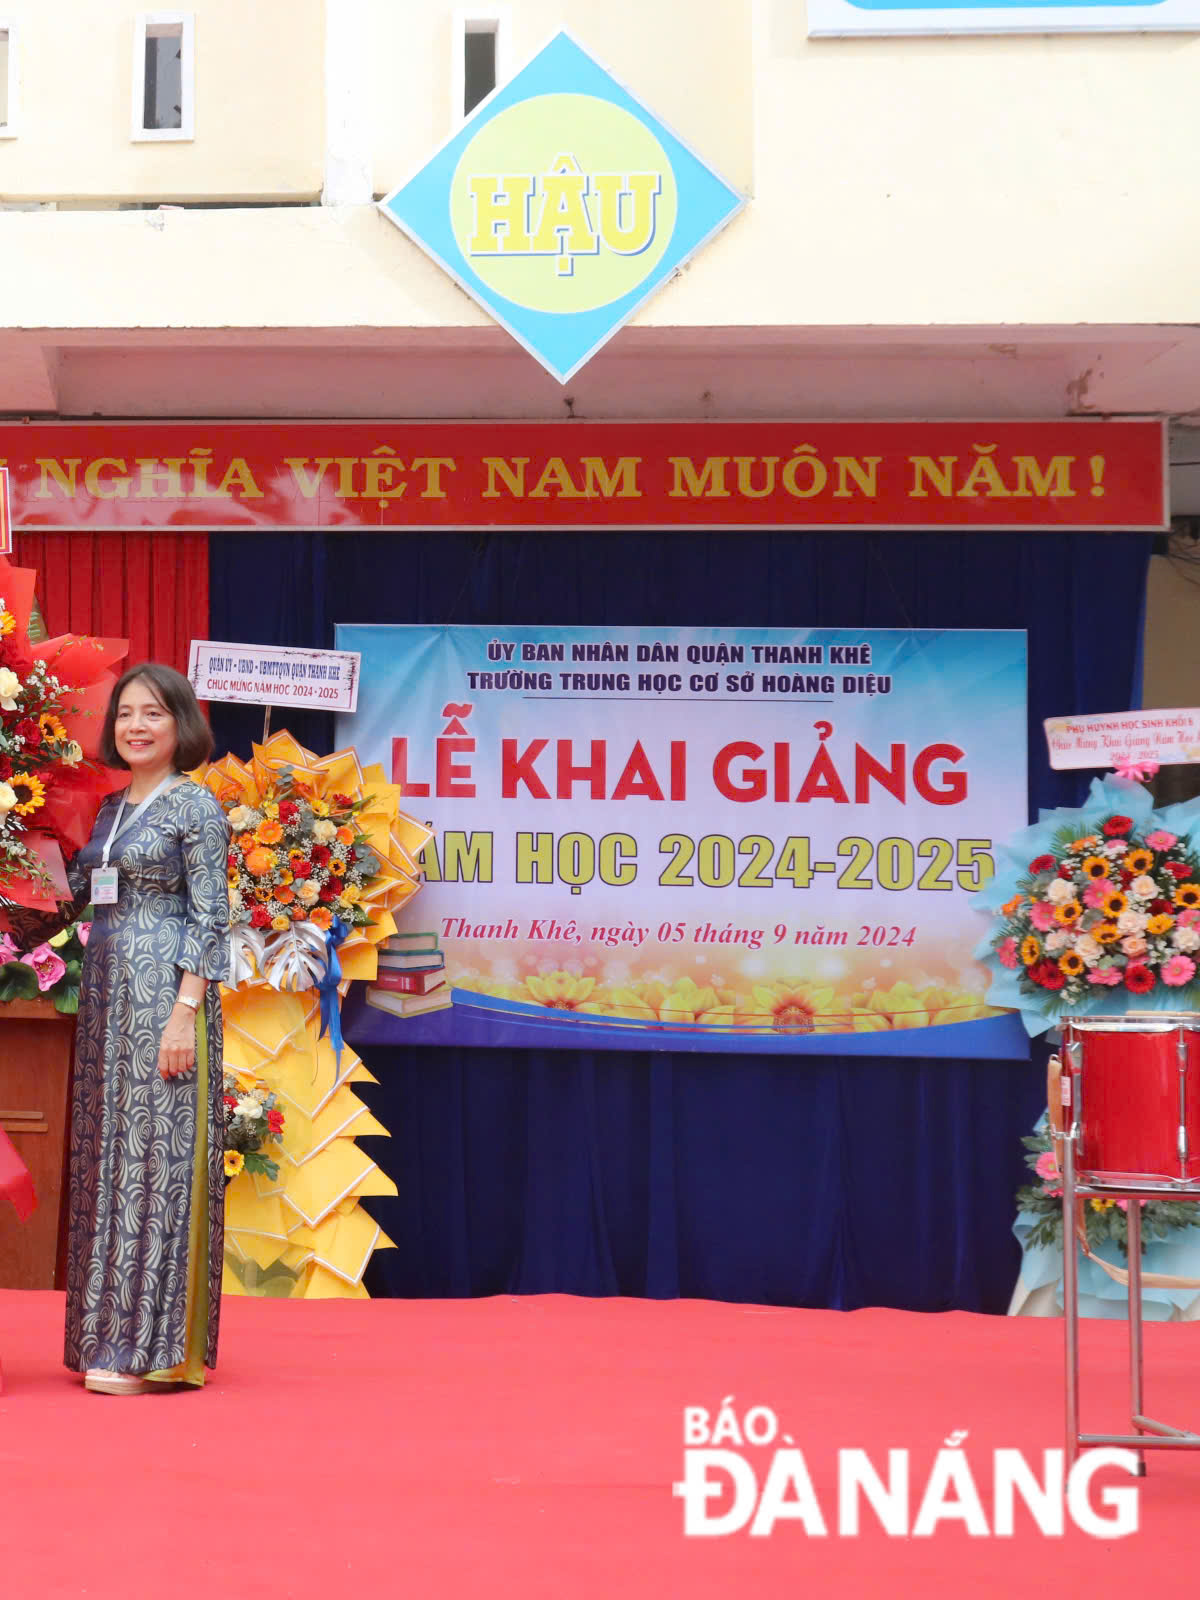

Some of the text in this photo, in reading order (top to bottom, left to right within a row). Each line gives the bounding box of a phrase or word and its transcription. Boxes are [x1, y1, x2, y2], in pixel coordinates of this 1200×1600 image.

[467, 152, 662, 277] HẬU
[34, 447, 265, 499] NGHĨA
[283, 446, 457, 509] VIỆT
[484, 457, 642, 498] NAM
[668, 443, 883, 498] MUÔN
[488, 642, 872, 666] ỦY BAN NHÂN DÂN QUẬN THANH KHÊ
[308, 664, 327, 679] THANH
[468, 669, 892, 697] TRƯỜNG TRUNG HỌC CƠ SỞ HOÀNG DIỆU
[293, 685, 312, 697] 2024
[318, 687, 339, 699] 2025
[391, 702, 968, 806] LỄ KHAI GIẢNG
[516, 832, 638, 895] HỌC
[658, 833, 995, 892] 2024-2025
[441, 917, 917, 949] Thanh Khê, ngày 05 tháng 9 năm 2024
